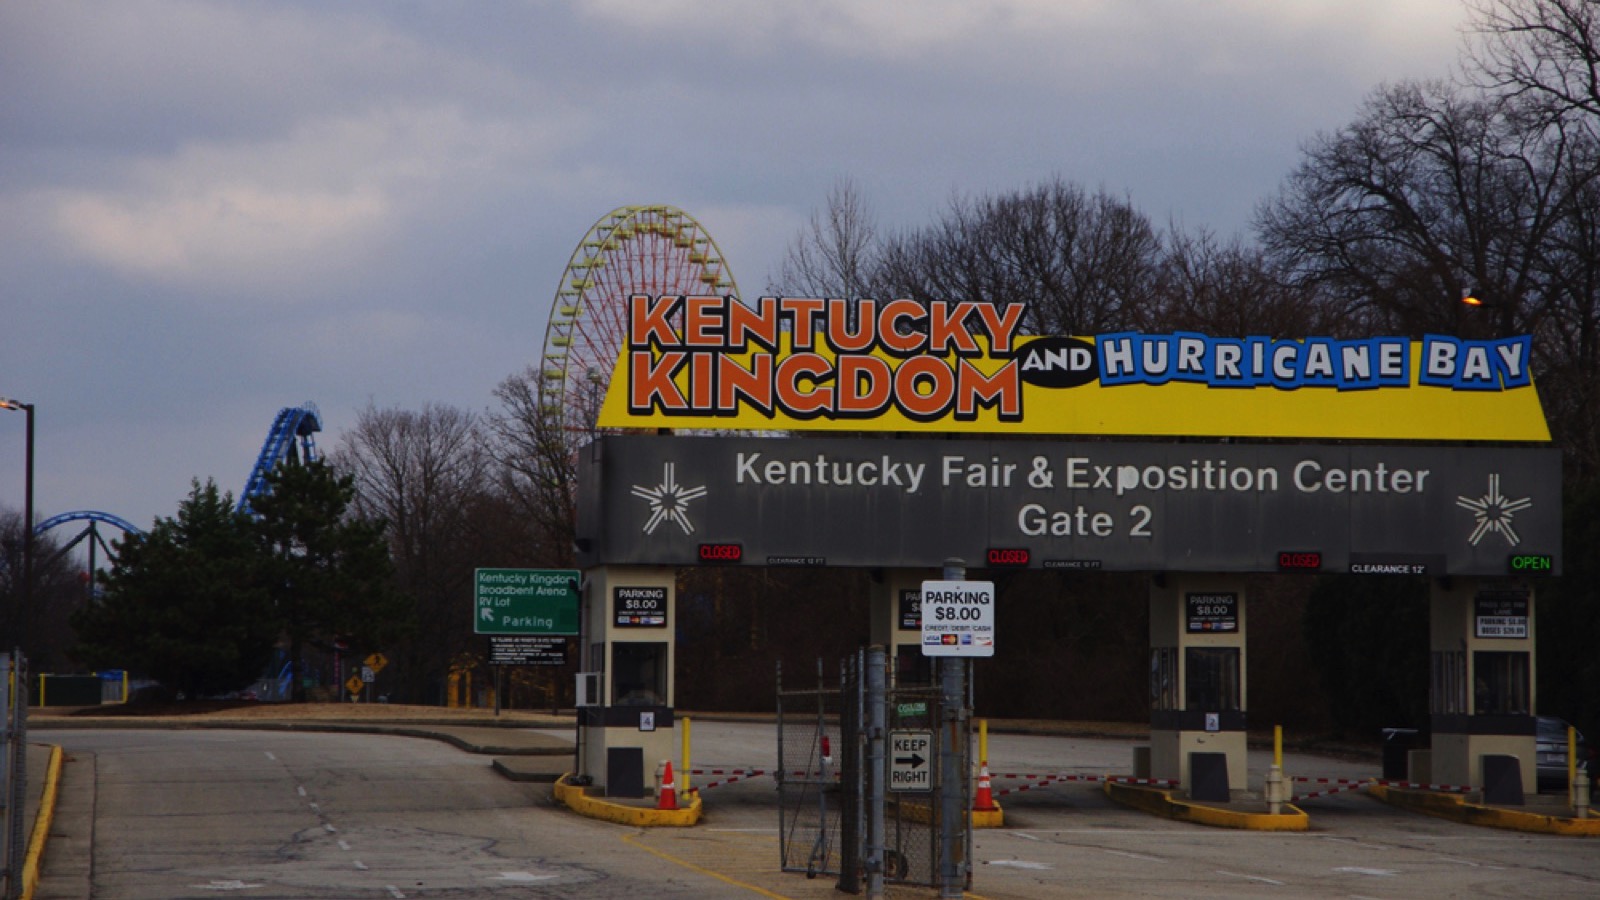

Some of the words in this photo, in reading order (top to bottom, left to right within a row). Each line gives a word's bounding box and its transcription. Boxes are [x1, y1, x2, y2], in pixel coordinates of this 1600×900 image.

[630, 295, 1027, 357] KENTUCKY
[1021, 347, 1092, 373] AND
[1101, 336, 1404, 380] HURRICANE
[1426, 341, 1523, 381] BAY
[630, 351, 1022, 421] KINGDOM
[736, 453, 926, 494] Kentucky
[942, 456, 1017, 489] Fair
[1028, 456, 1054, 490] &
[1066, 457, 1279, 496] Exposition
[1293, 460, 1430, 494] Center
[1018, 504, 1114, 538] Gate
[1129, 505, 1153, 537] 2
[702, 546, 741, 560] CLOSED
[989, 550, 1028, 564] CLOSED
[769, 557, 806, 565] CLEARANCE
[1280, 553, 1319, 567] CLOSED
[1512, 556, 1551, 569] OPEN
[1351, 564, 1410, 574] CLEARANCE
[479, 572, 528, 585] Kentucky
[479, 584, 534, 596] Broadbent
[536, 586, 568, 597] Arena
[618, 590, 664, 599] PARKING
[479, 597, 493, 607] RV
[495, 597, 511, 608] Lot
[625, 600, 657, 609] $8.00
[926, 591, 990, 605] PARKING
[1190, 596, 1233, 605] PARKING
[935, 607, 981, 621] $8.00
[1197, 605, 1228, 615] $8.00
[502, 615, 554, 630] Parking
[894, 740, 928, 752] KEEP
[892, 771, 928, 783] RIGHT
